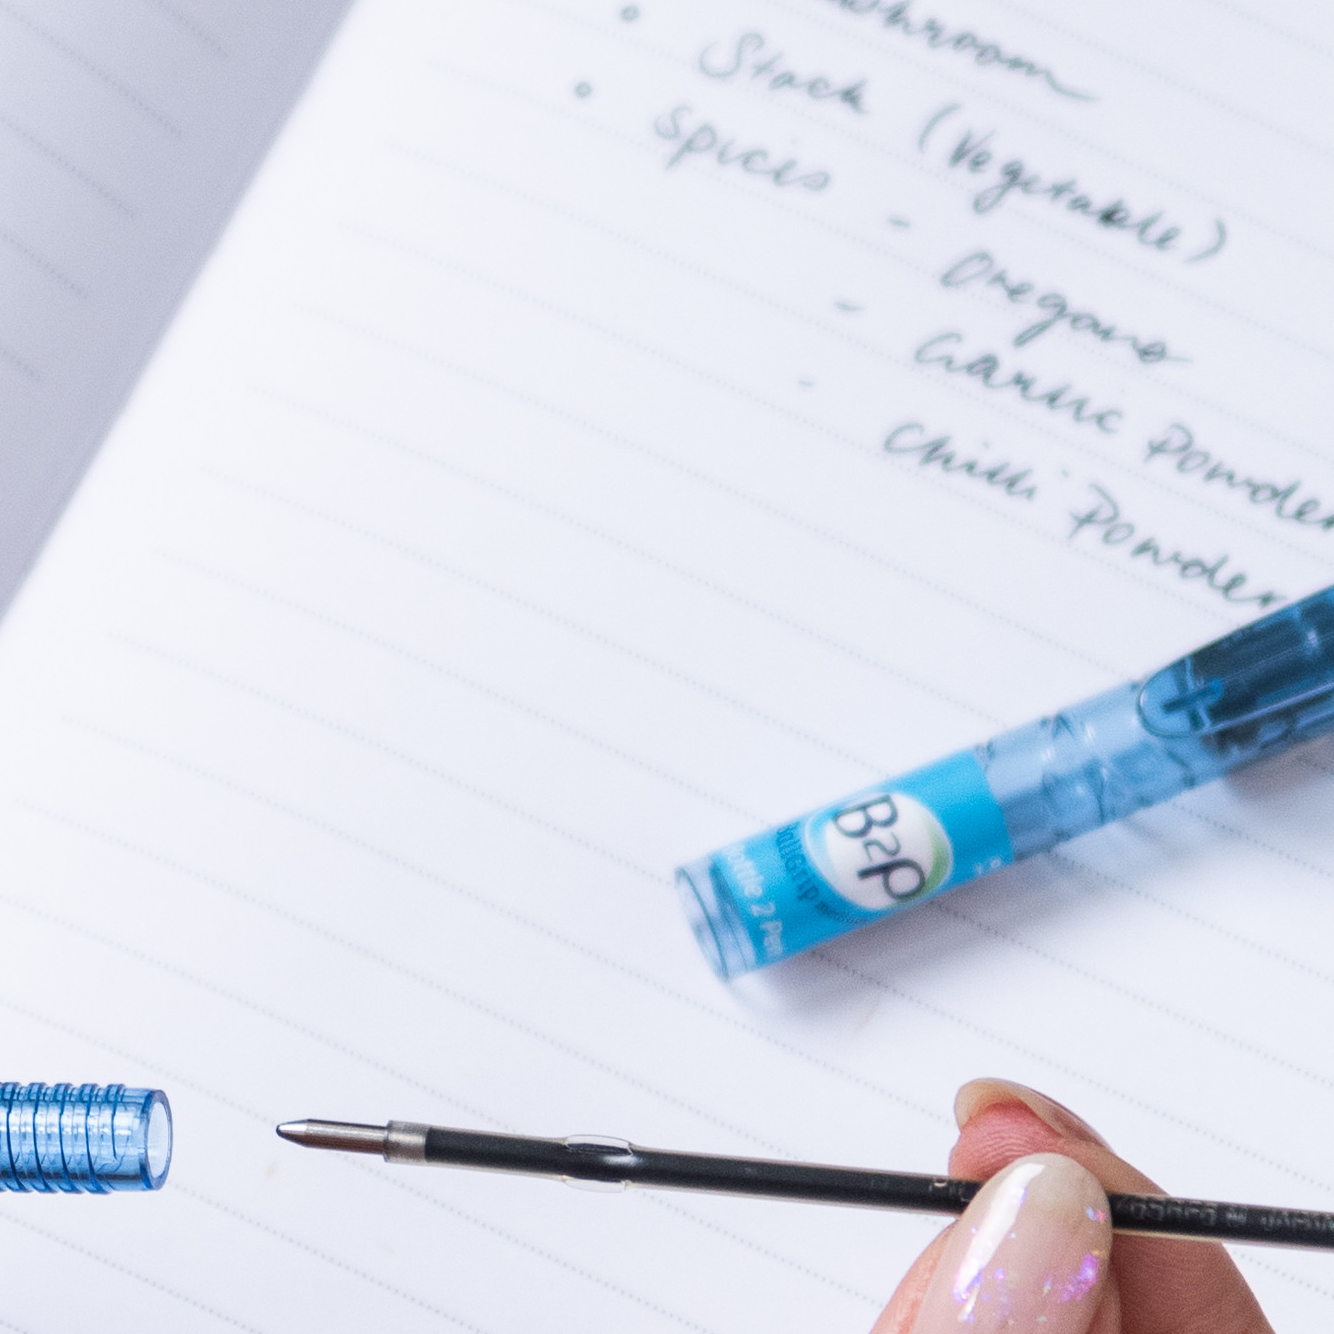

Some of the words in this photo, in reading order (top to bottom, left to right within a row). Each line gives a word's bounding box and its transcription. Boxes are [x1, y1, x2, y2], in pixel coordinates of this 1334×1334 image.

[698, 31, 869, 114] Stock
[918, 102, 1227, 262] (Vegetable)
[938, 251, 1194, 364] Oregano
[1067, 481, 1289, 607] Powder
[830, 794, 926, 901] B2P
